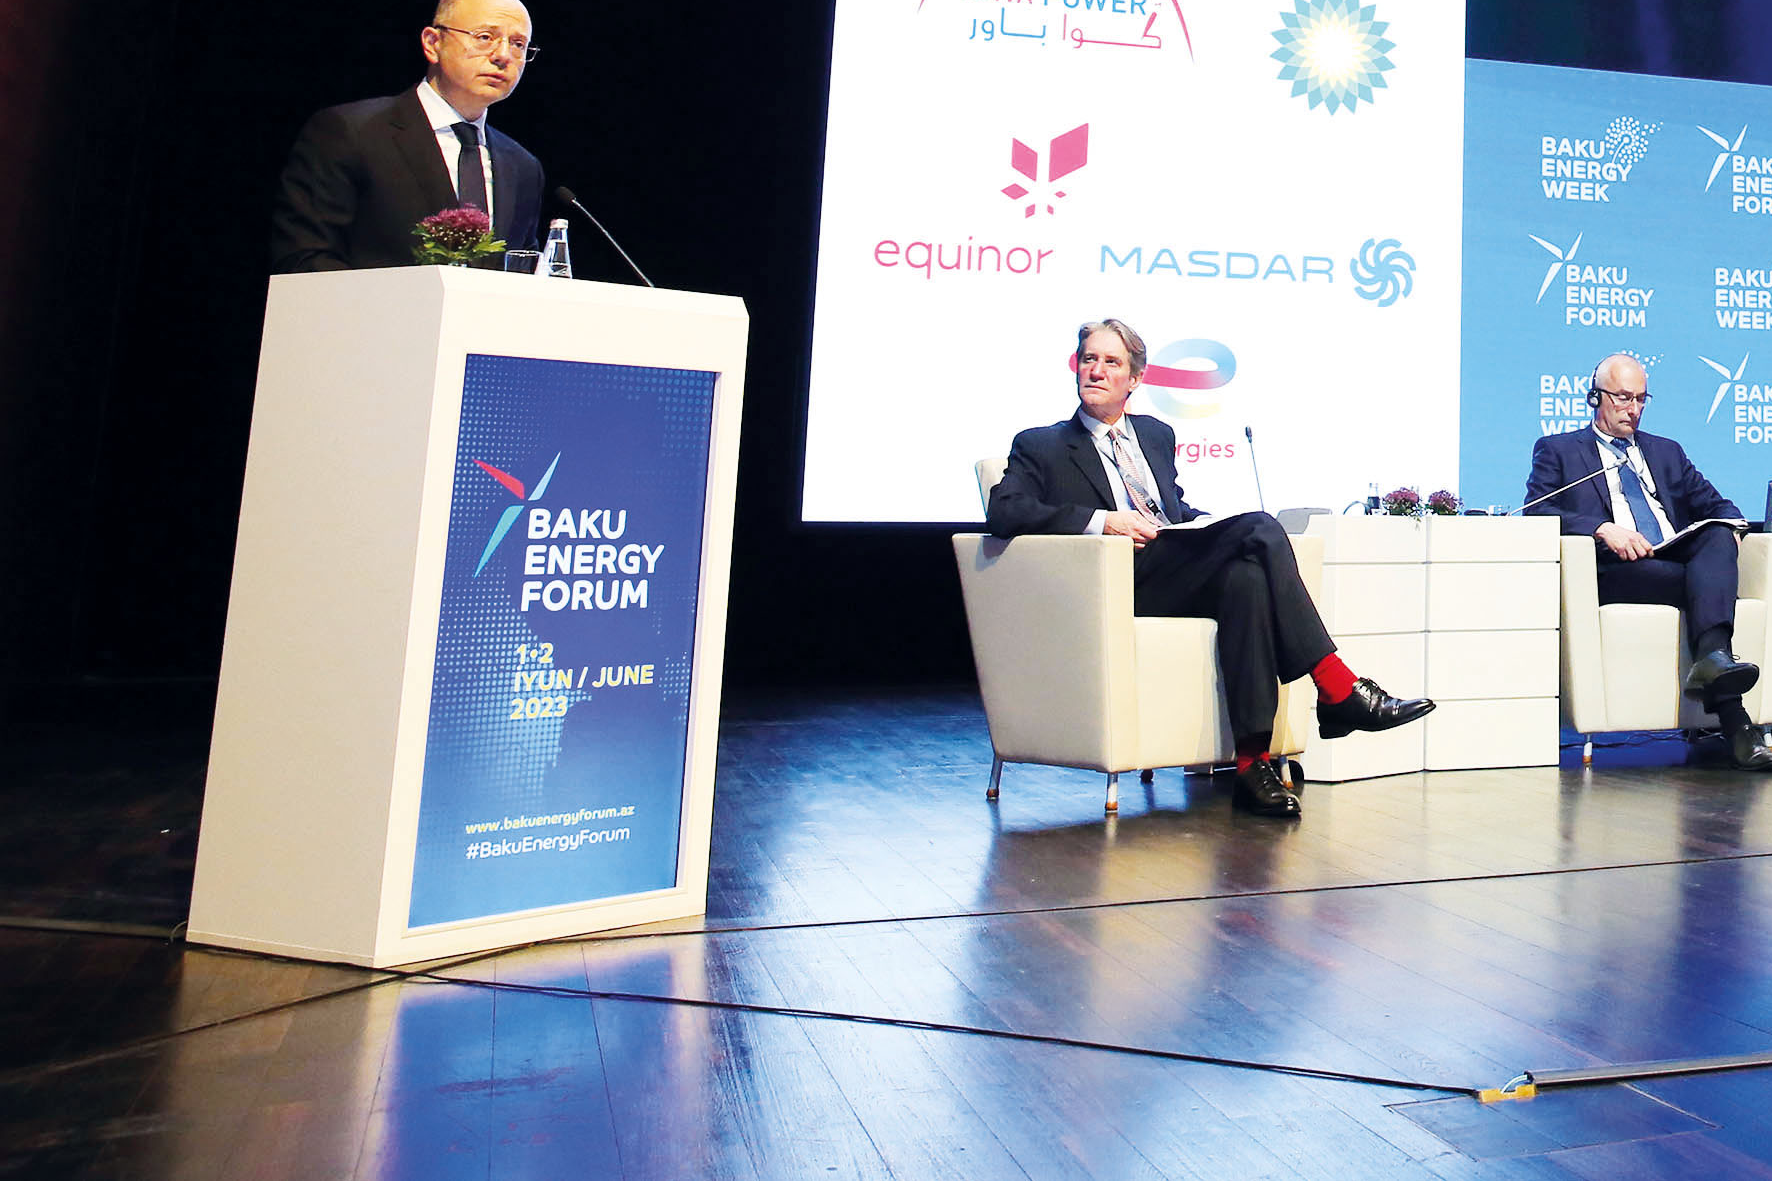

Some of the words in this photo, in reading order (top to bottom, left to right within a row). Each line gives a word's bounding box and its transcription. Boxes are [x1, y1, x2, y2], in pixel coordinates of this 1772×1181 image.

[1542, 137, 1605, 159] BAKU
[1542, 158, 1632, 182] ENERGY
[1542, 180, 1610, 202] WEEK
[873, 236, 1054, 279] equinor
[1100, 245, 1333, 284] MASDAR
[1566, 265, 1628, 285] BAKU
[1566, 287, 1654, 307] ENERGY
[1566, 307, 1646, 327] FORUM
[1540, 375, 1593, 394] BAK
[1540, 397, 1594, 416] ENE
[1176, 438, 1235, 463] rgies
[527, 508, 627, 540] BAKU
[523, 543, 664, 576] ENERGY
[520, 579, 648, 612] FORUM
[514, 666, 573, 692] İYUN
[592, 665, 654, 688] JUNE
[510, 696, 568, 720] 2023
[466, 805, 635, 834] www.bakuenergyforum.az
[466, 828, 630, 860] #BakuEnergyForum
